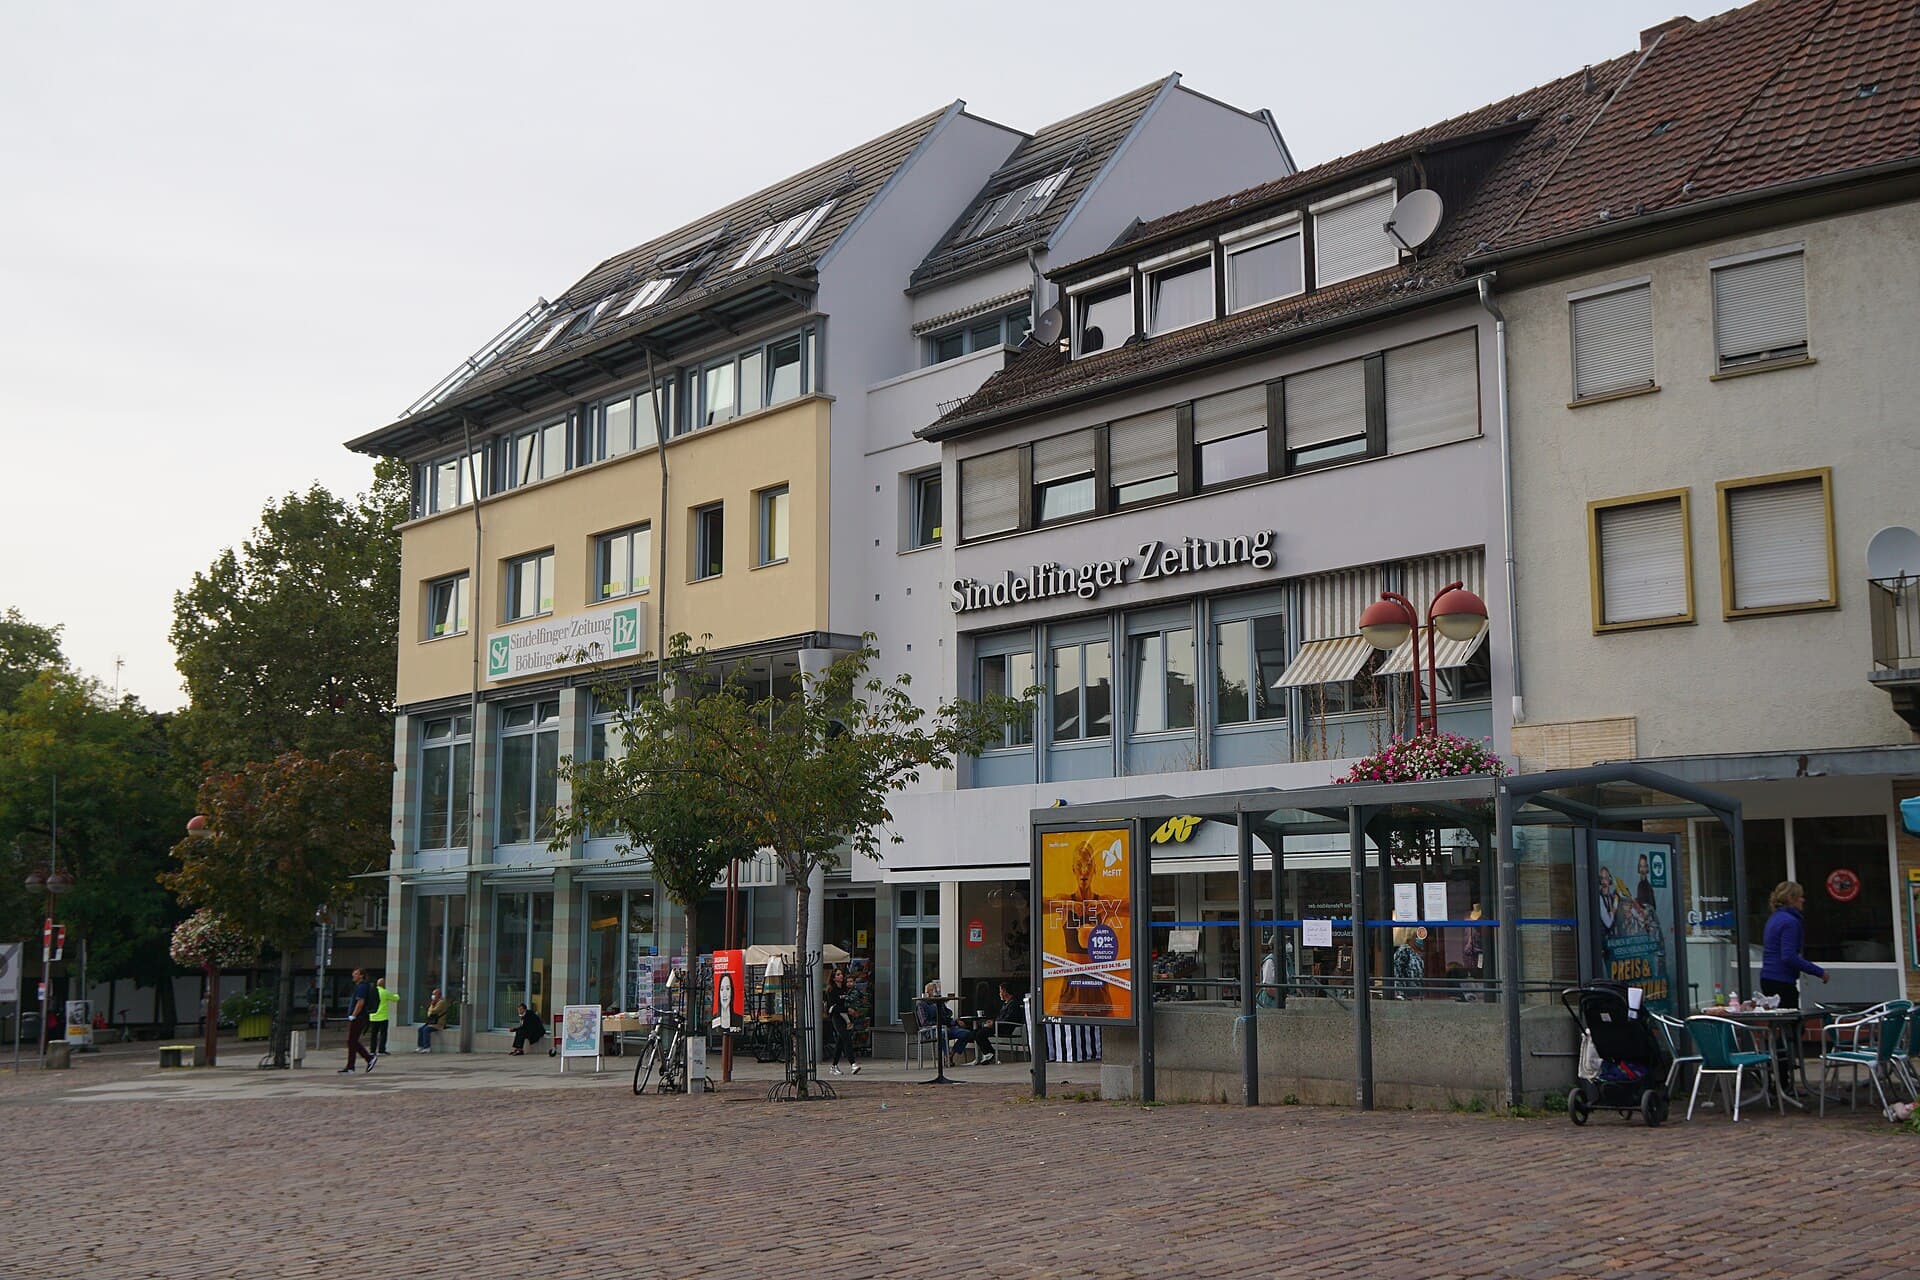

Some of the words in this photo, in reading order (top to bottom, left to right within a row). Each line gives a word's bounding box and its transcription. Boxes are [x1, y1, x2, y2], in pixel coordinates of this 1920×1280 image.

[950, 556, 1131, 613] Sindelfinger
[1137, 528, 1277, 580] Zeitung
[510, 626, 569, 650] Sindelfinger
[571, 617, 612, 638] Zeitung
[564, 643, 605, 663] Zeung
[1048, 899, 1123, 929] FLEX
[1611, 957, 1641, 981] PREIS
[1642, 958, 1651, 977] &
